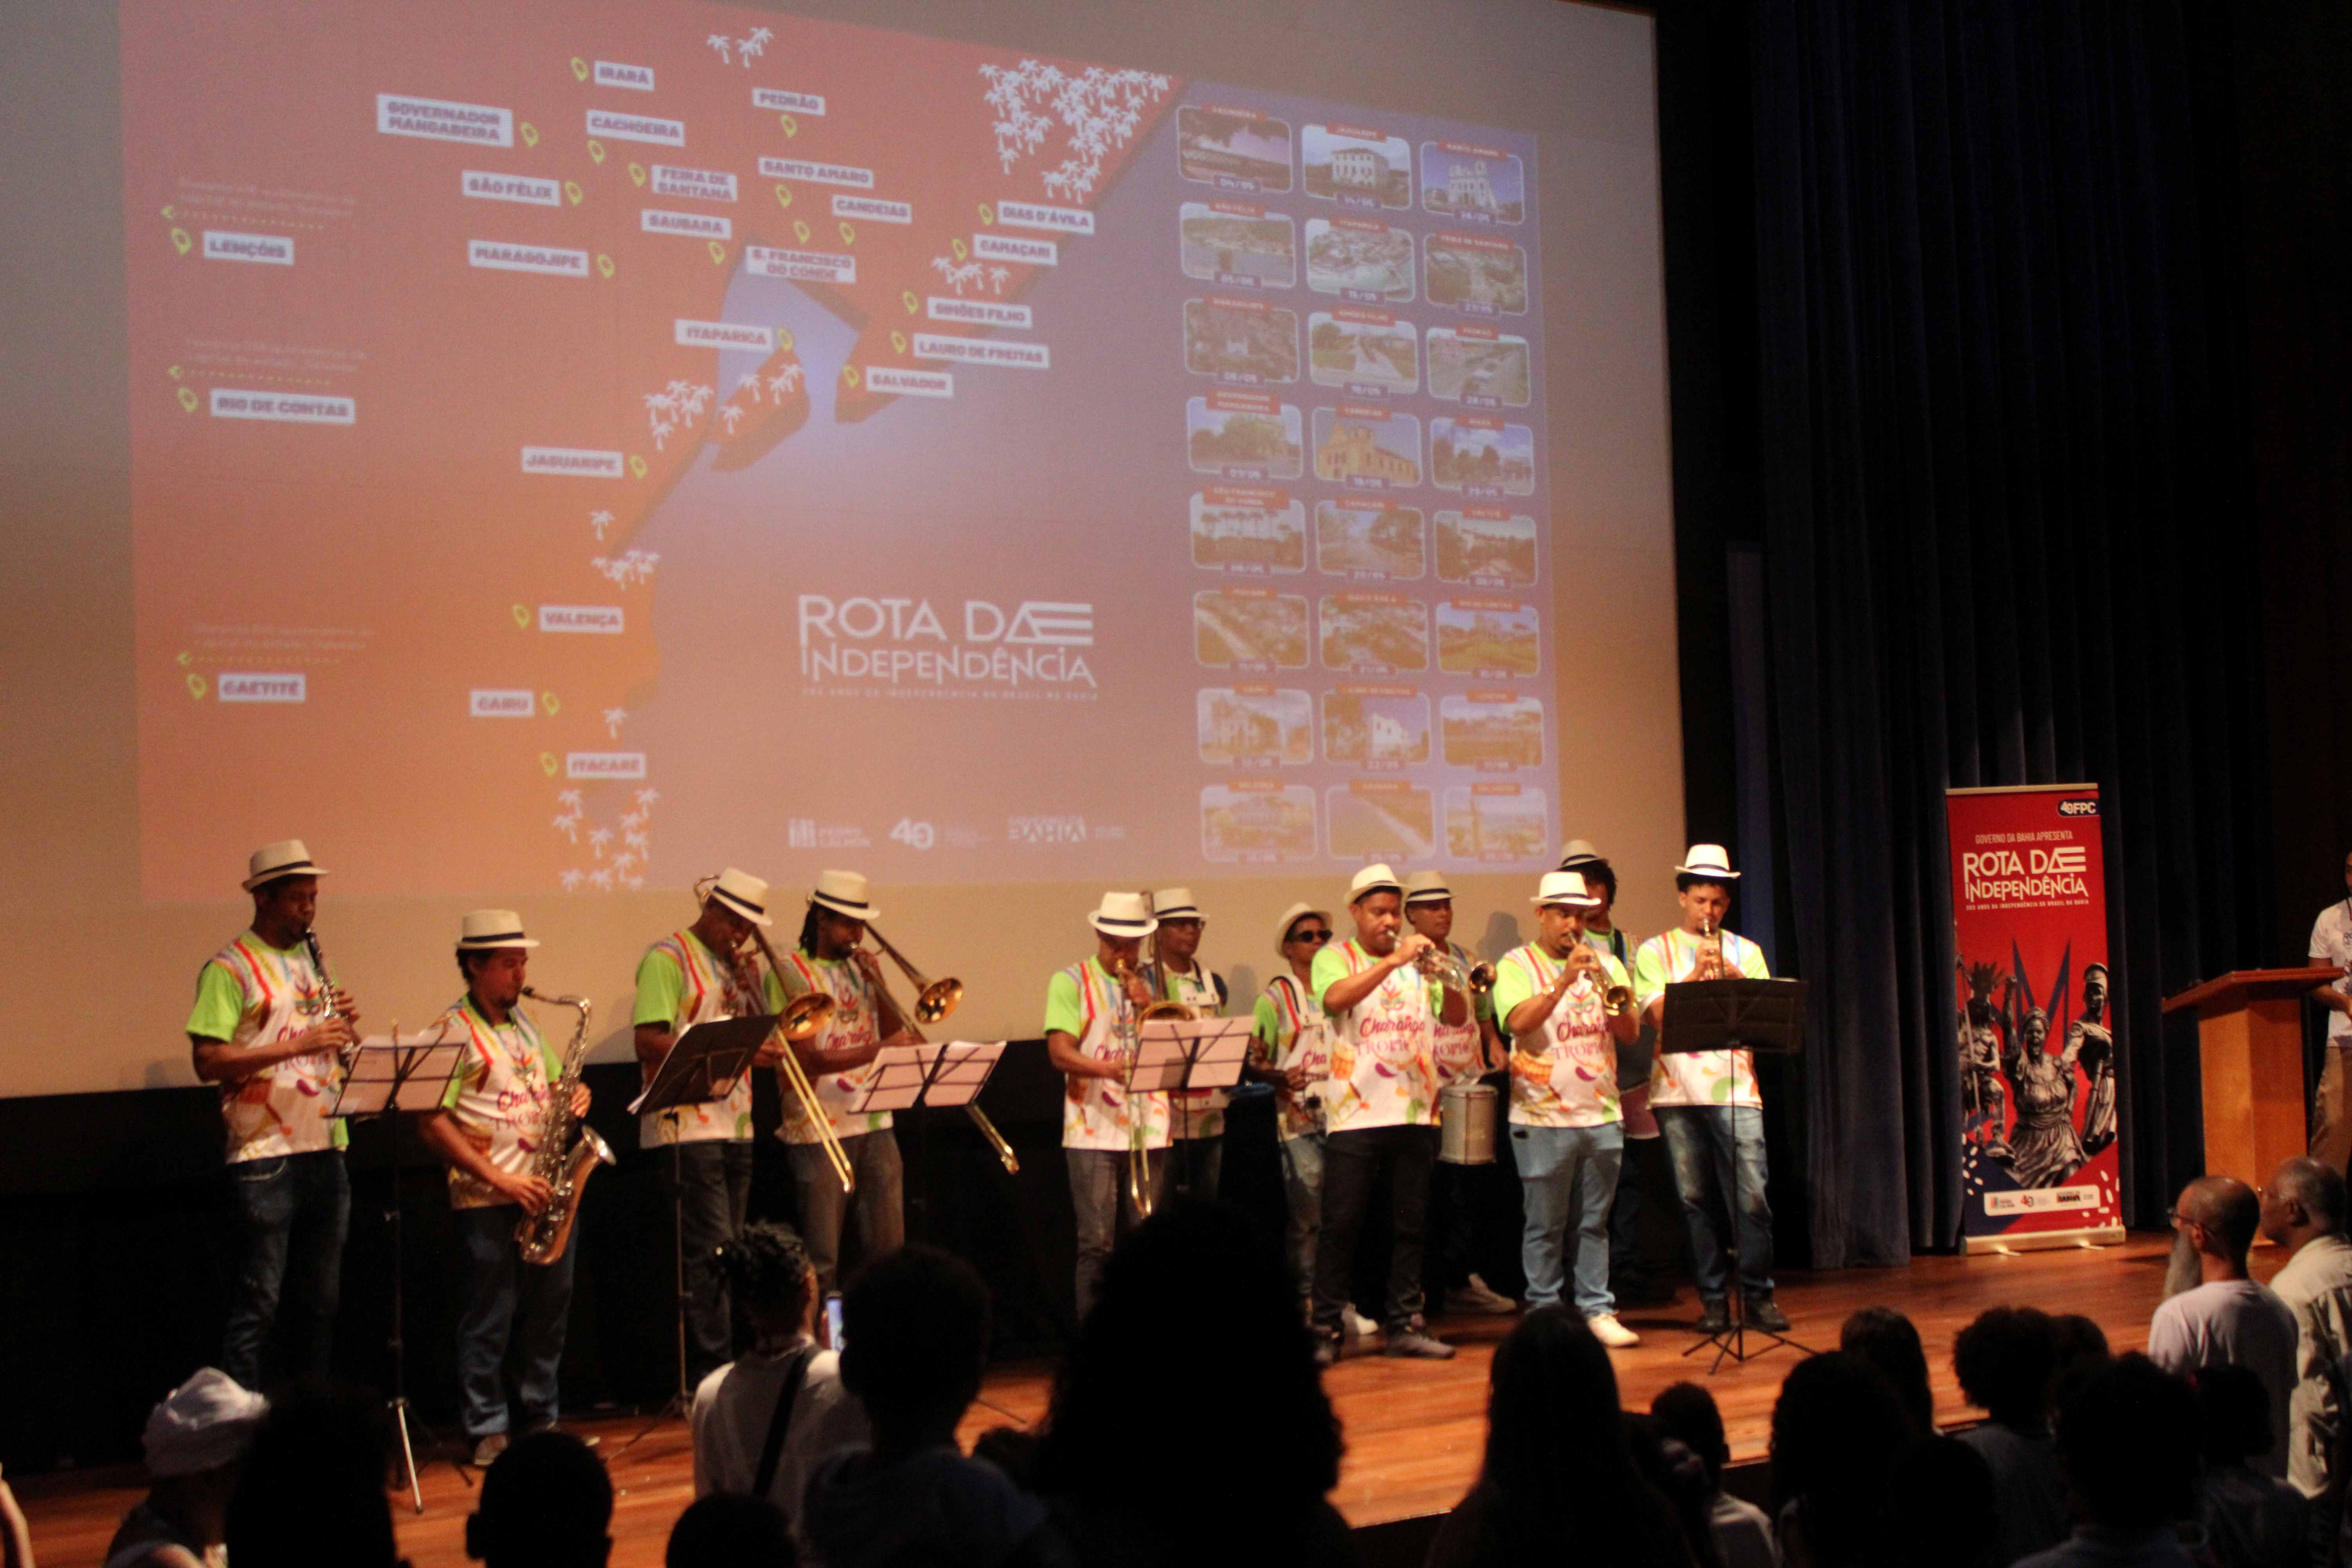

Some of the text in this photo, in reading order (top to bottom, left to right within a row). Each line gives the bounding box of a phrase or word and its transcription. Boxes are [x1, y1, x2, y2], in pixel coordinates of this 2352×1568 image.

[388, 101, 500, 126] GOVERNADOR
[388, 116, 500, 142] MANGABEIRA
[591, 116, 681, 138] CACHOEIRA
[661, 168, 729, 186] FEIRA DE
[762, 159, 869, 185] SANTO AMARO
[835, 198, 909, 218] CANDEIAS
[1002, 205, 1034, 221] DIAS
[648, 214, 724, 234] SAUBARA
[979, 238, 1051, 259] CAMAÇARI
[771, 250, 851, 270] FRANCISCO
[788, 265, 838, 280] CONDE
[988, 306, 1026, 323] FILHO
[686, 327, 768, 346] ITAPARICA
[919, 341, 1044, 364] LAURO DE FREITAS
[872, 374, 947, 391] SALVADOR
[543, 612, 620, 628] VALENÇA
[798, 594, 947, 646] ROTA
[801, 643, 1098, 688] INDEPENDÊNCIA
[1975, 830, 2073, 844] GOVERNO DA BAHIA APRESENTA
[1963, 851, 2025, 882] ROTA
[1965, 873, 2089, 902] INDEPENDÊNCIA
